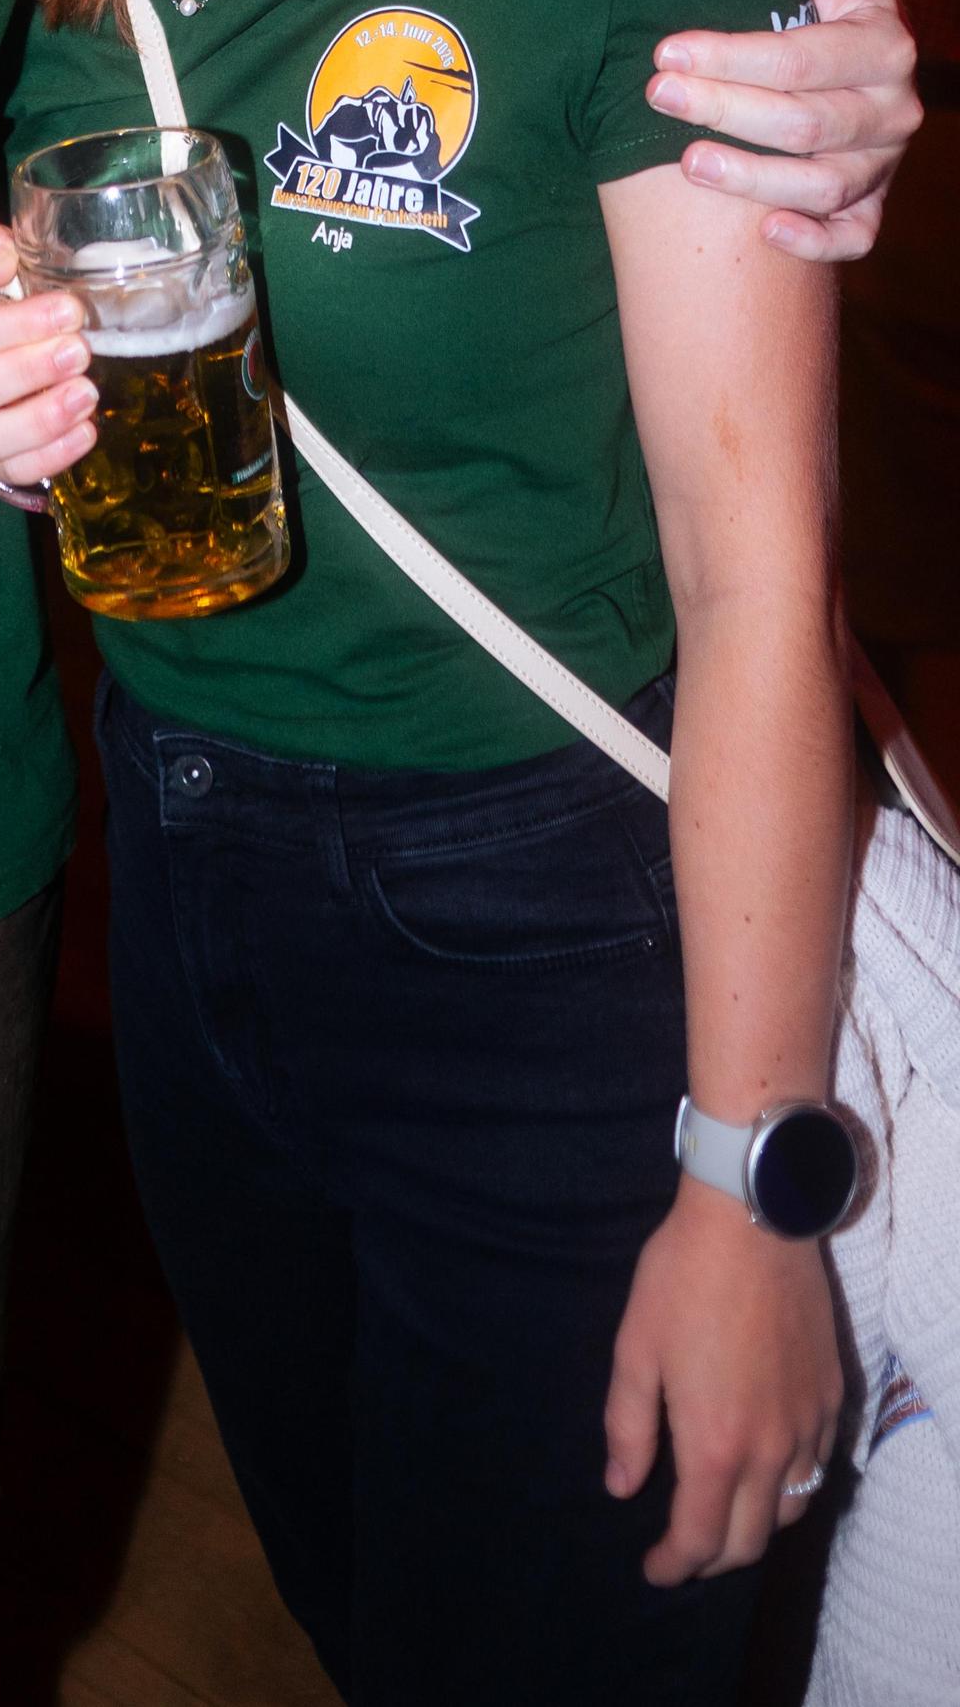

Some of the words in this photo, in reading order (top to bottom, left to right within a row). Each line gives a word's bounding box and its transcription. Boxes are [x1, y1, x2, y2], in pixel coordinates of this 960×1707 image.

[402, 22, 433, 43] Juni
[431, 36, 455, 68] 2026
[297, 163, 342, 200] 120
[342, 172, 424, 213] Jahre
[311, 221, 354, 253] Anja
